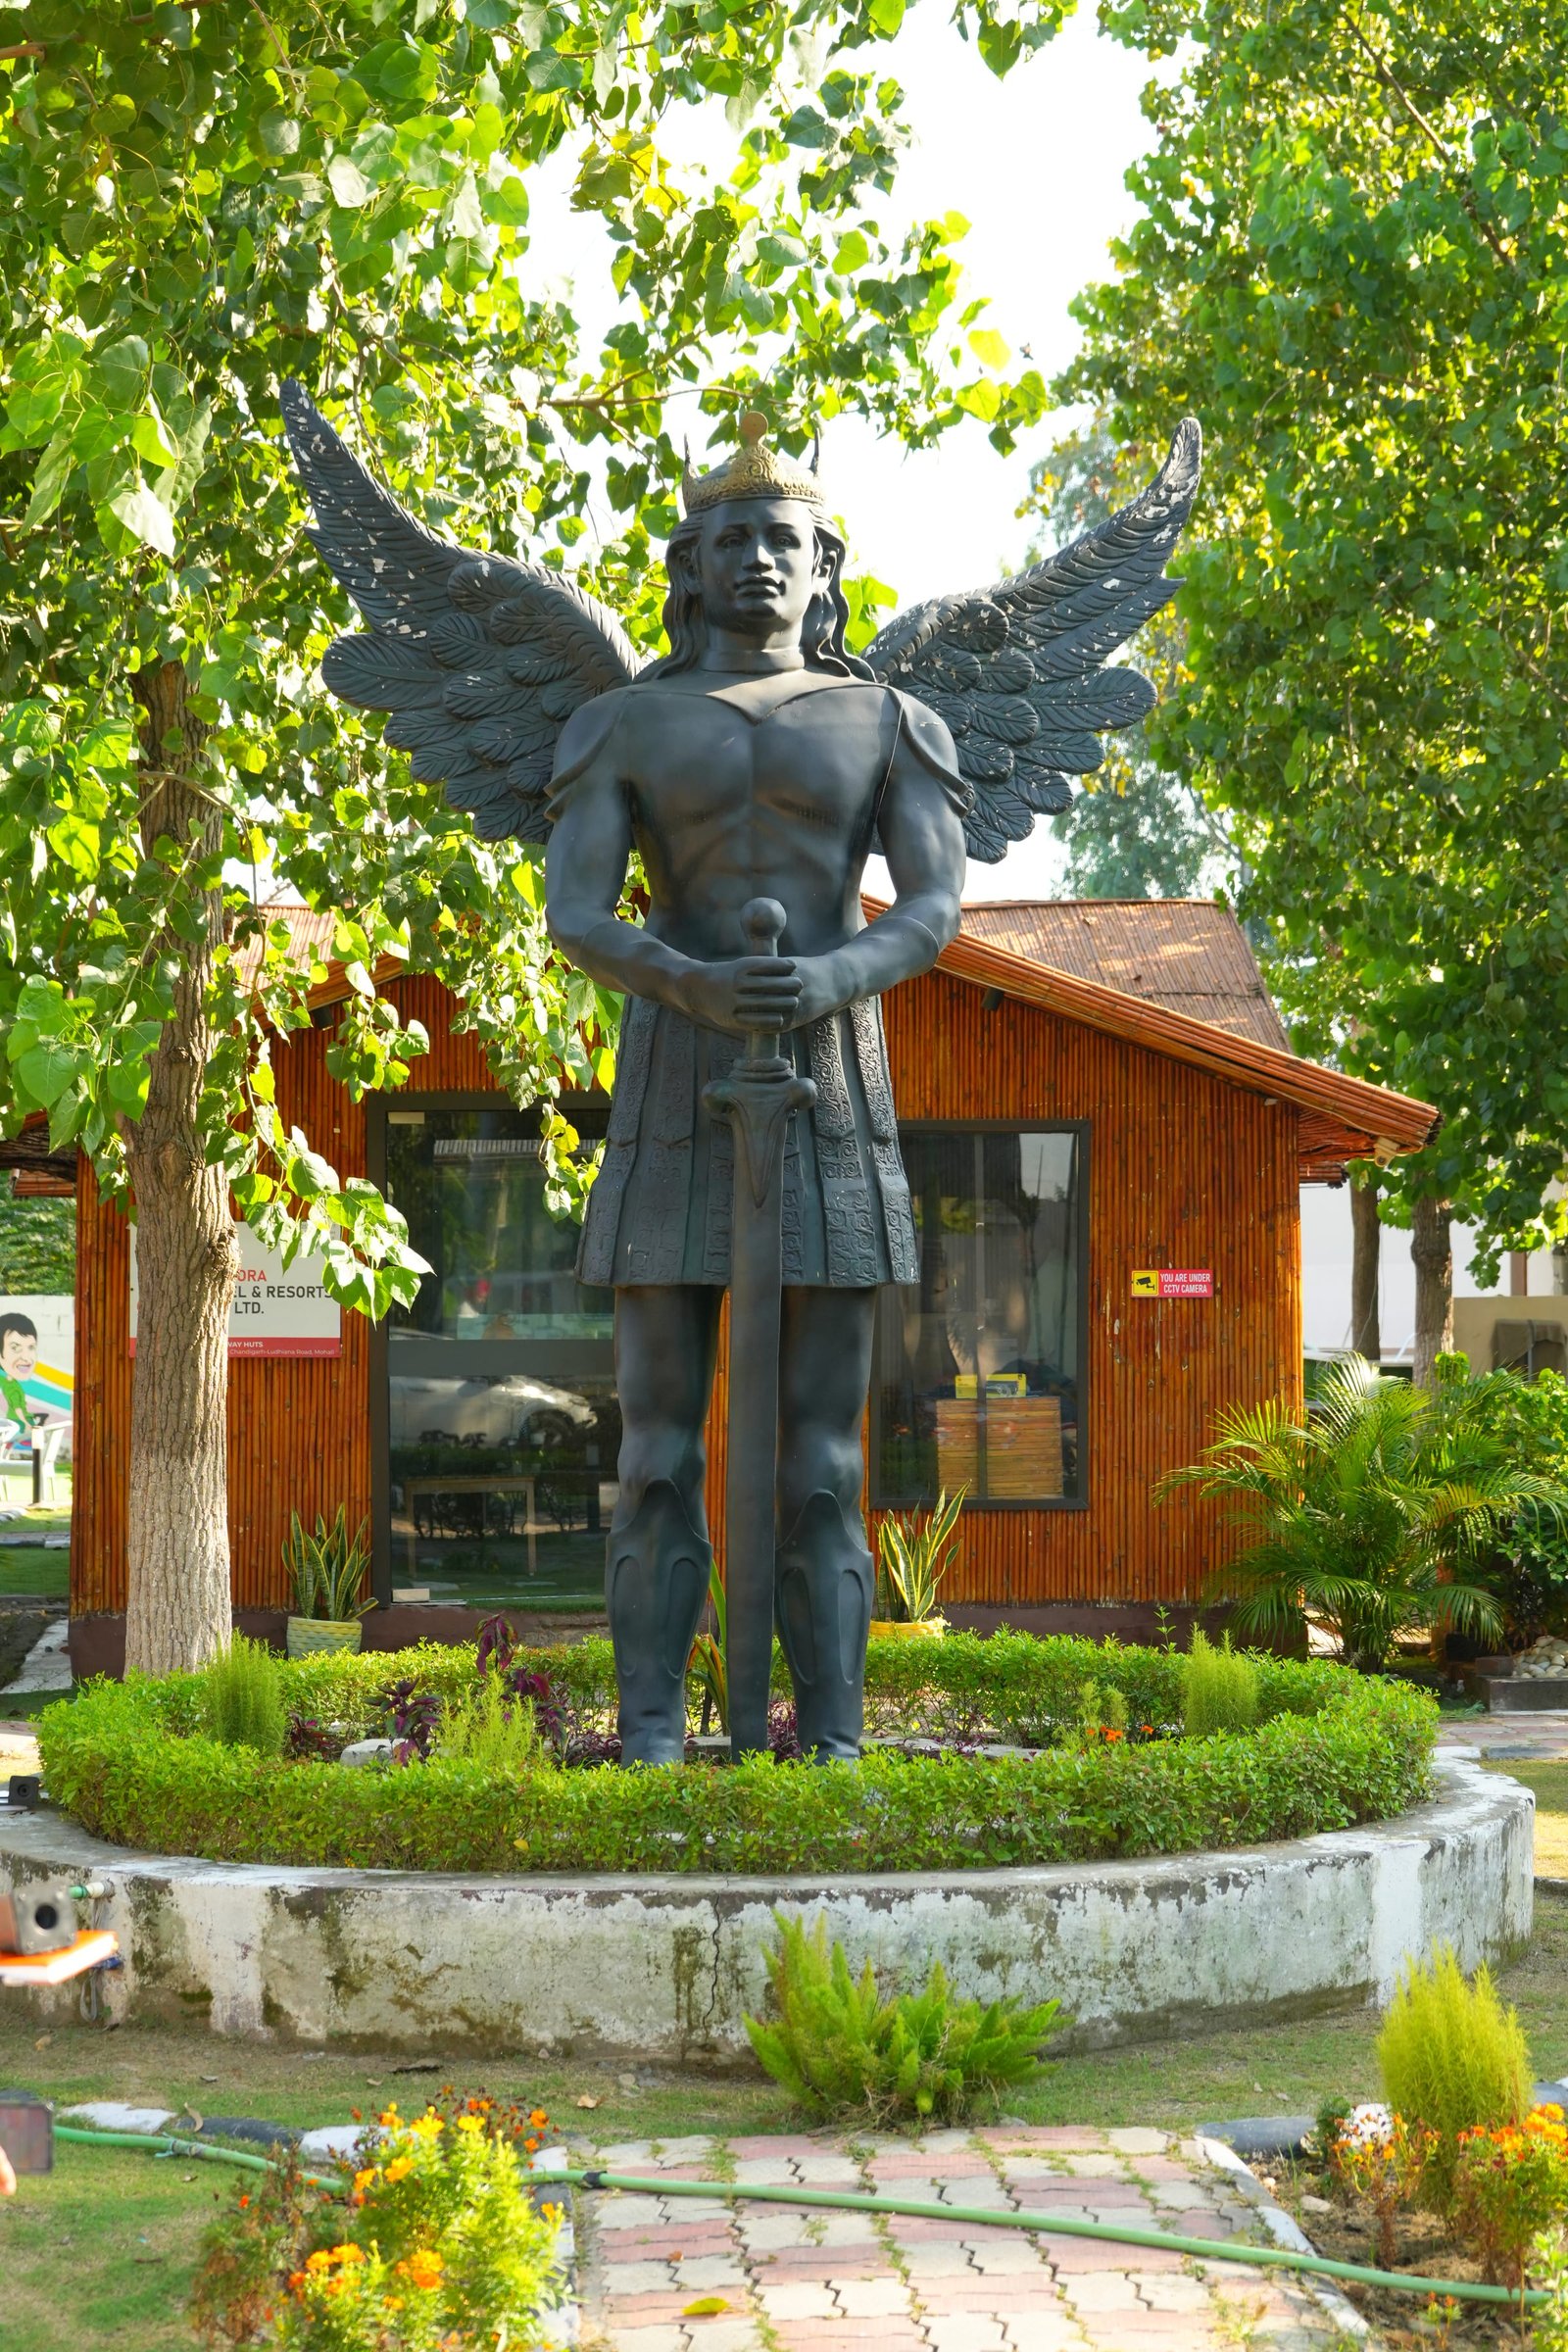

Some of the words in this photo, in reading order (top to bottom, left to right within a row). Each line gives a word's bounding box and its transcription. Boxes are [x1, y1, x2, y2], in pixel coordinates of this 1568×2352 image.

[1160, 1273, 1173, 1283] YOU
[1175, 1273, 1187, 1283] ARE
[1189, 1273, 1210, 1283] UNDER
[252, 1286, 261, 1298] &
[1163, 1284, 1179, 1294] CCTV
[1181, 1284, 1207, 1294] CAMERA
[235, 1301, 264, 1314] LTD.
